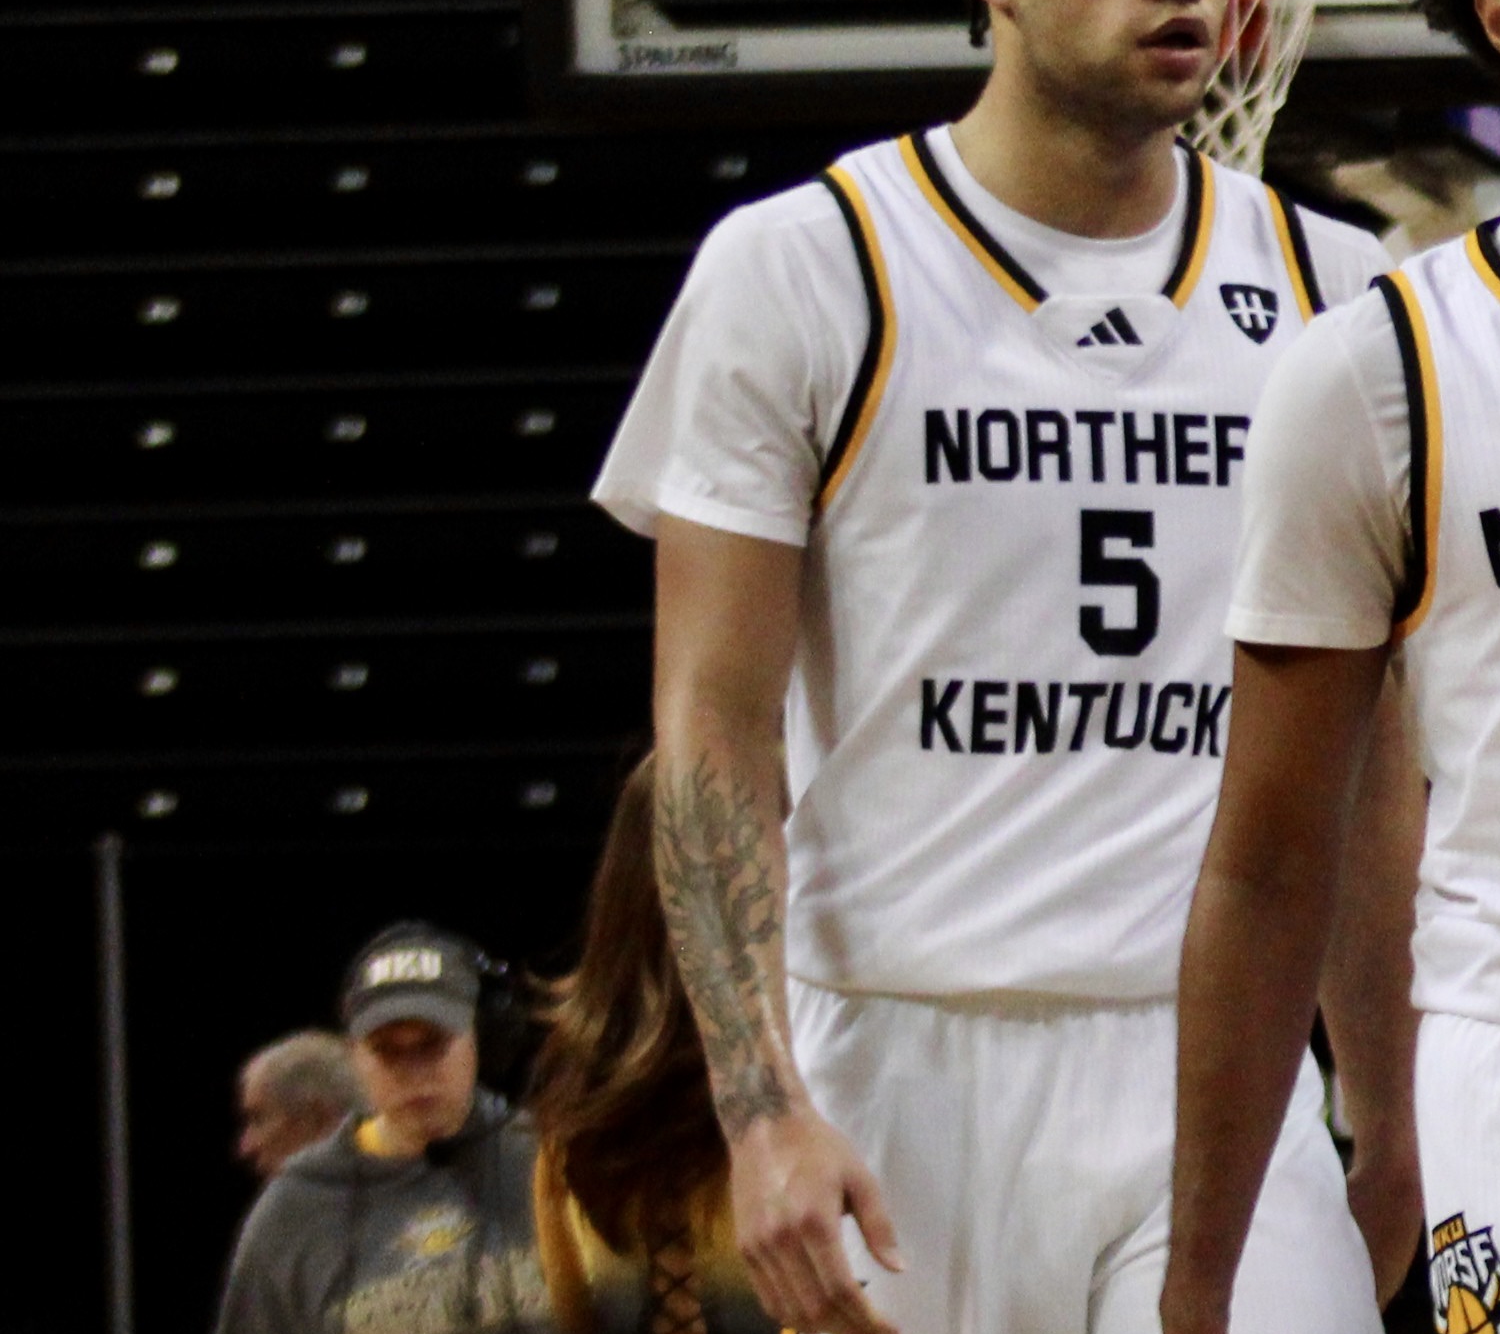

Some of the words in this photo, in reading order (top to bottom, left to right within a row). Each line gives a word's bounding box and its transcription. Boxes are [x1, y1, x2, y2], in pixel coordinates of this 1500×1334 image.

[924, 409, 1252, 487] NORTHER
[1079, 509, 1160, 657] 5
[919, 679, 1233, 757] KENTUCK
